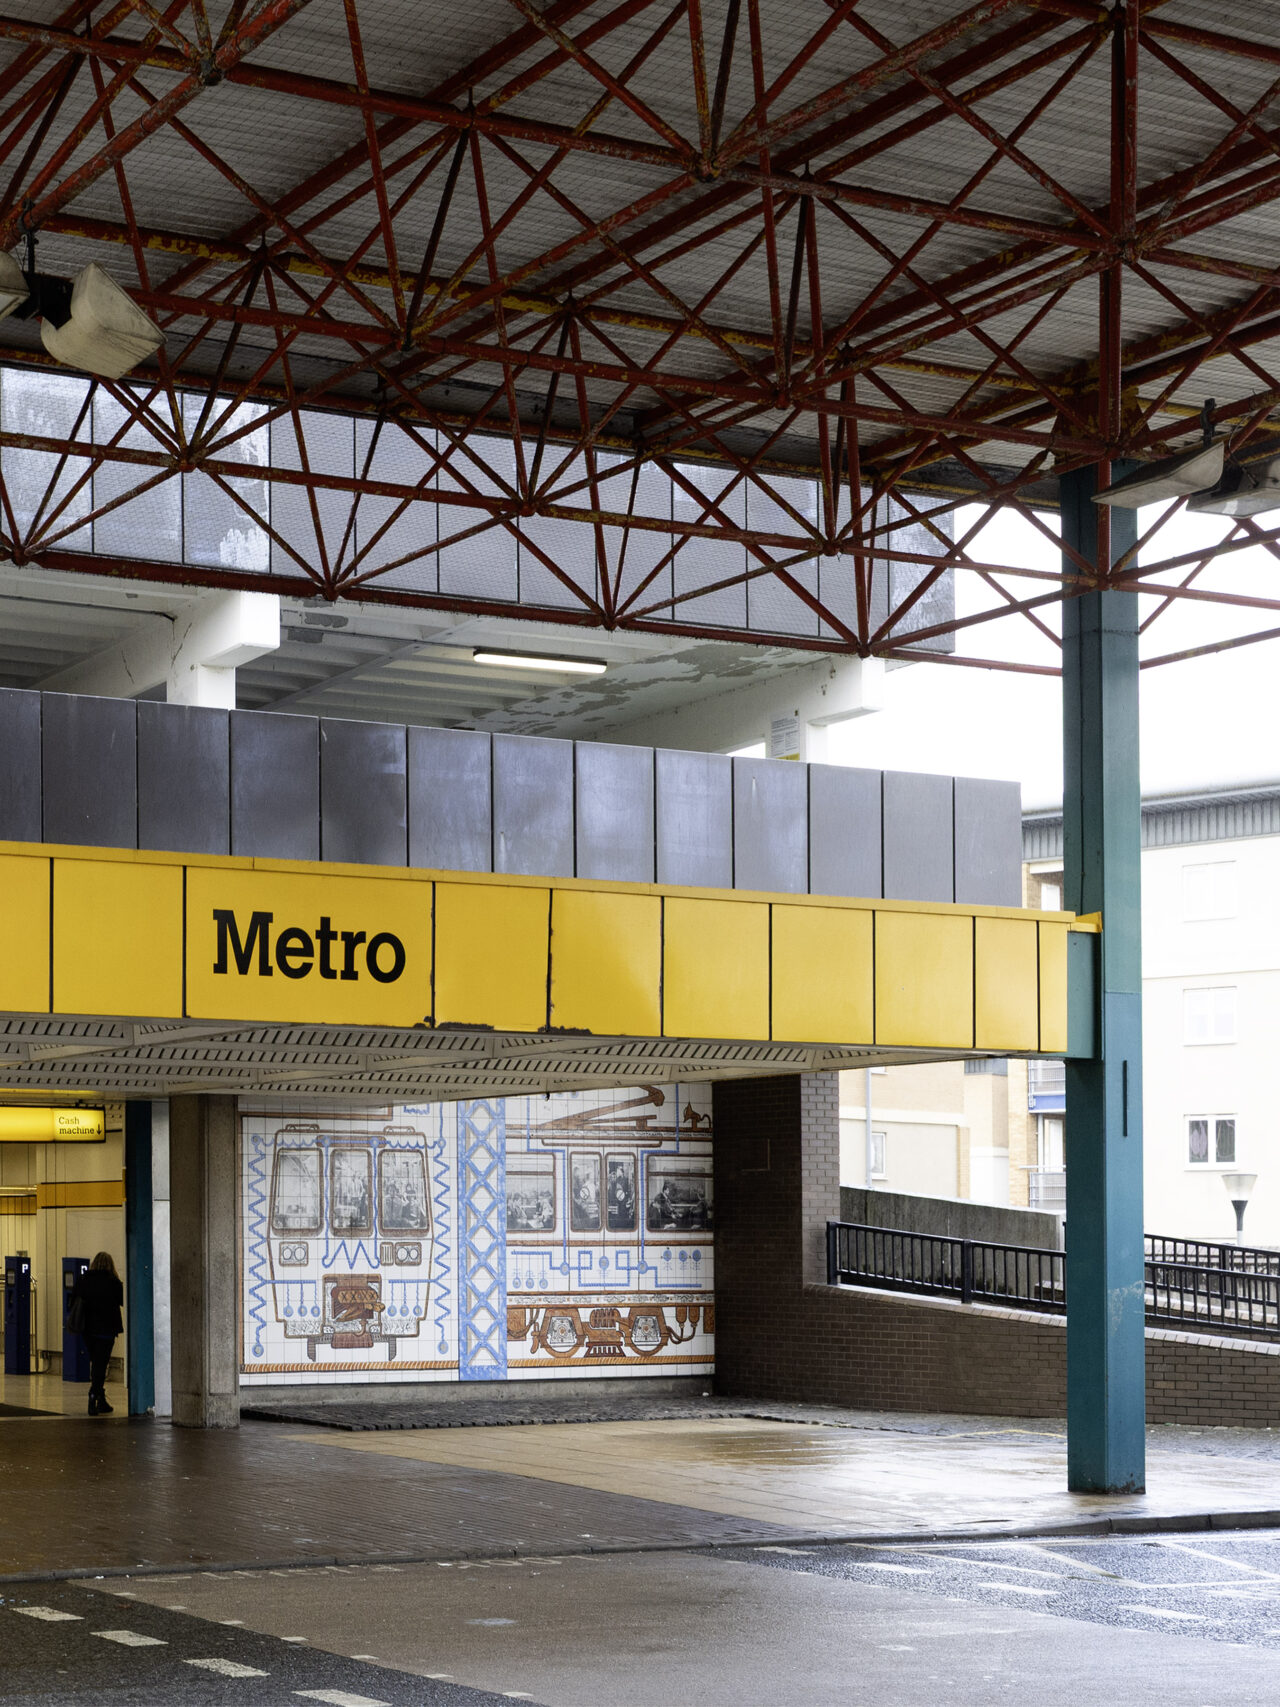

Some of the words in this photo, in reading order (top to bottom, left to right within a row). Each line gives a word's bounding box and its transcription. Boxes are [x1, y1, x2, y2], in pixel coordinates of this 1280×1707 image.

[213, 909, 406, 983] Metro
[58, 1116, 80, 1125] Cash
[59, 1126, 95, 1135] machine
[22, 1263, 29, 1274] P
